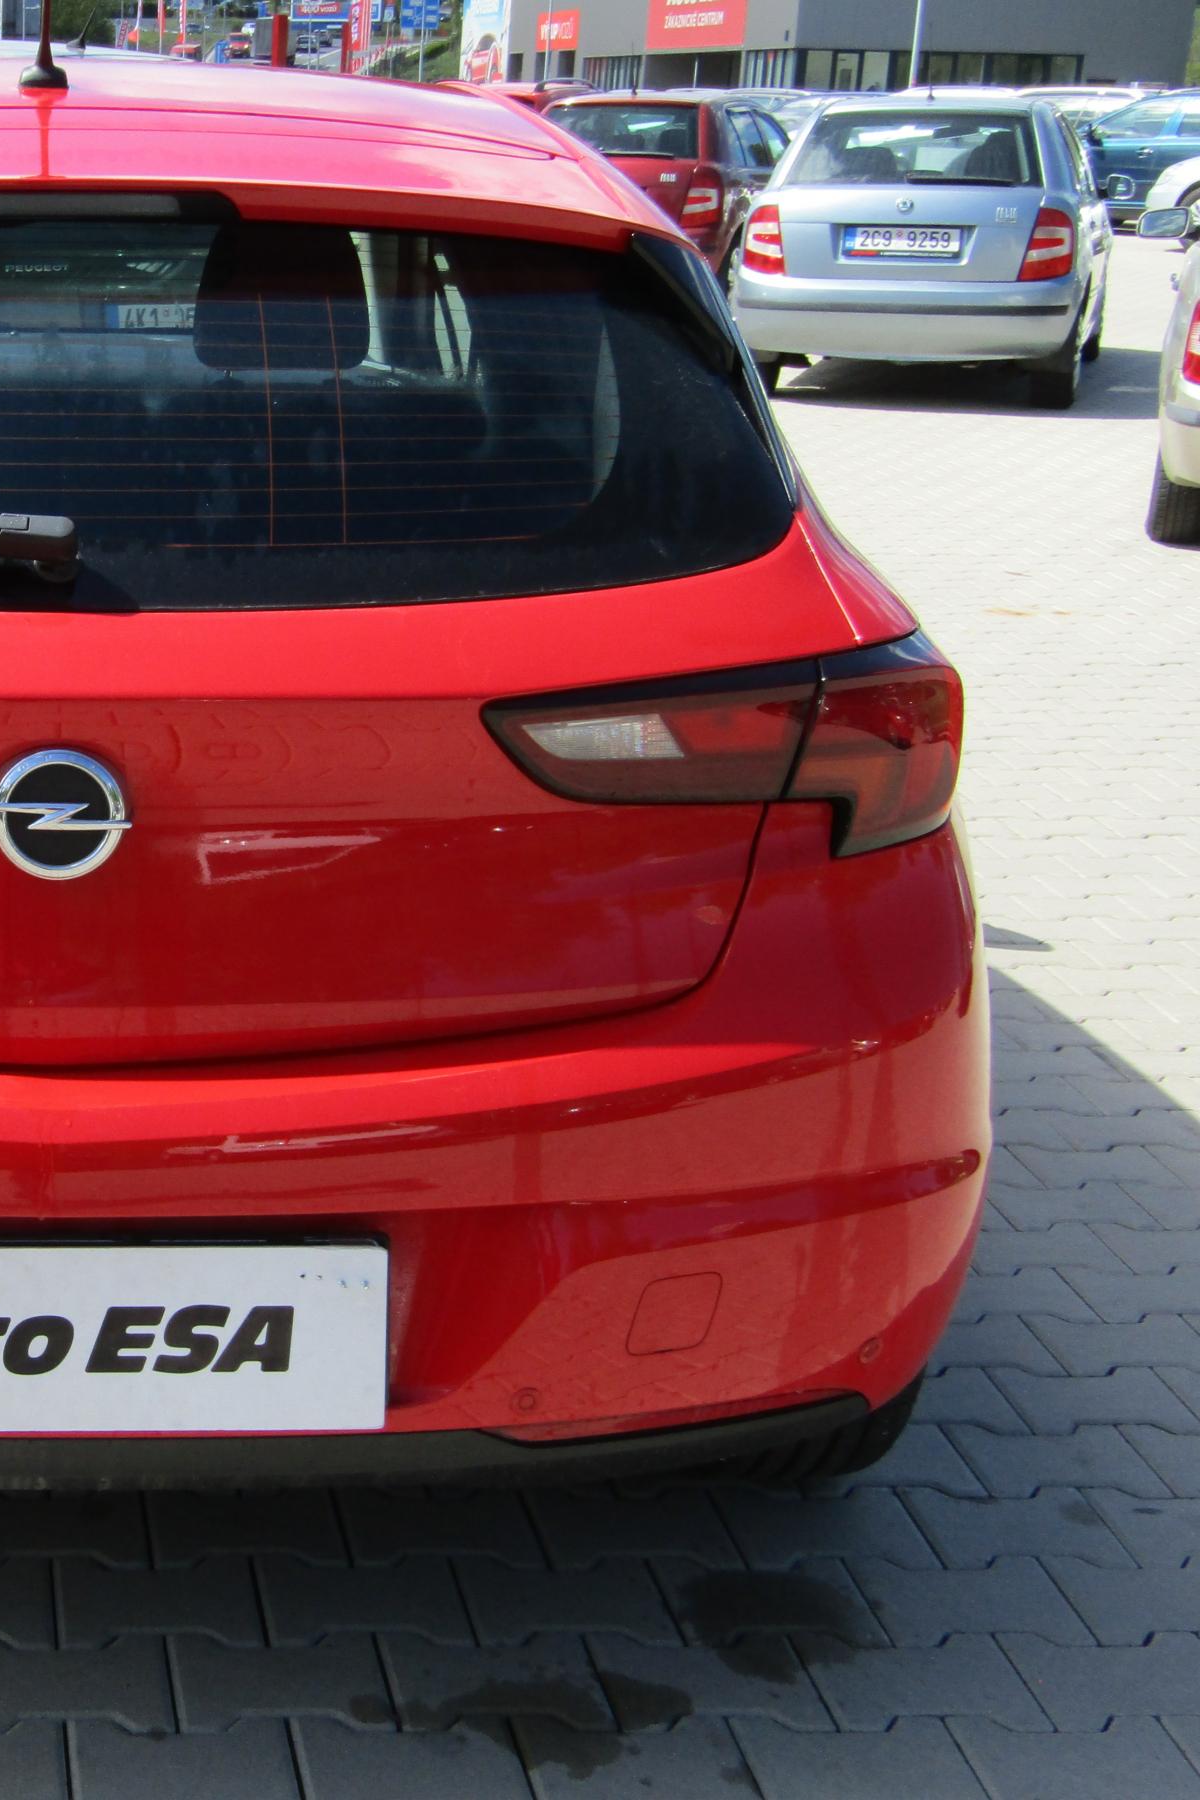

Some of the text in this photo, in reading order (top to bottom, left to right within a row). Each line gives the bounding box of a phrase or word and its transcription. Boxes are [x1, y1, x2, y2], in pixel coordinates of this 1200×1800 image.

[860, 230, 951, 249] 2C9 9259
[5, 264, 69, 273] PEUGEOT
[85, 1304, 295, 1374] ESA
